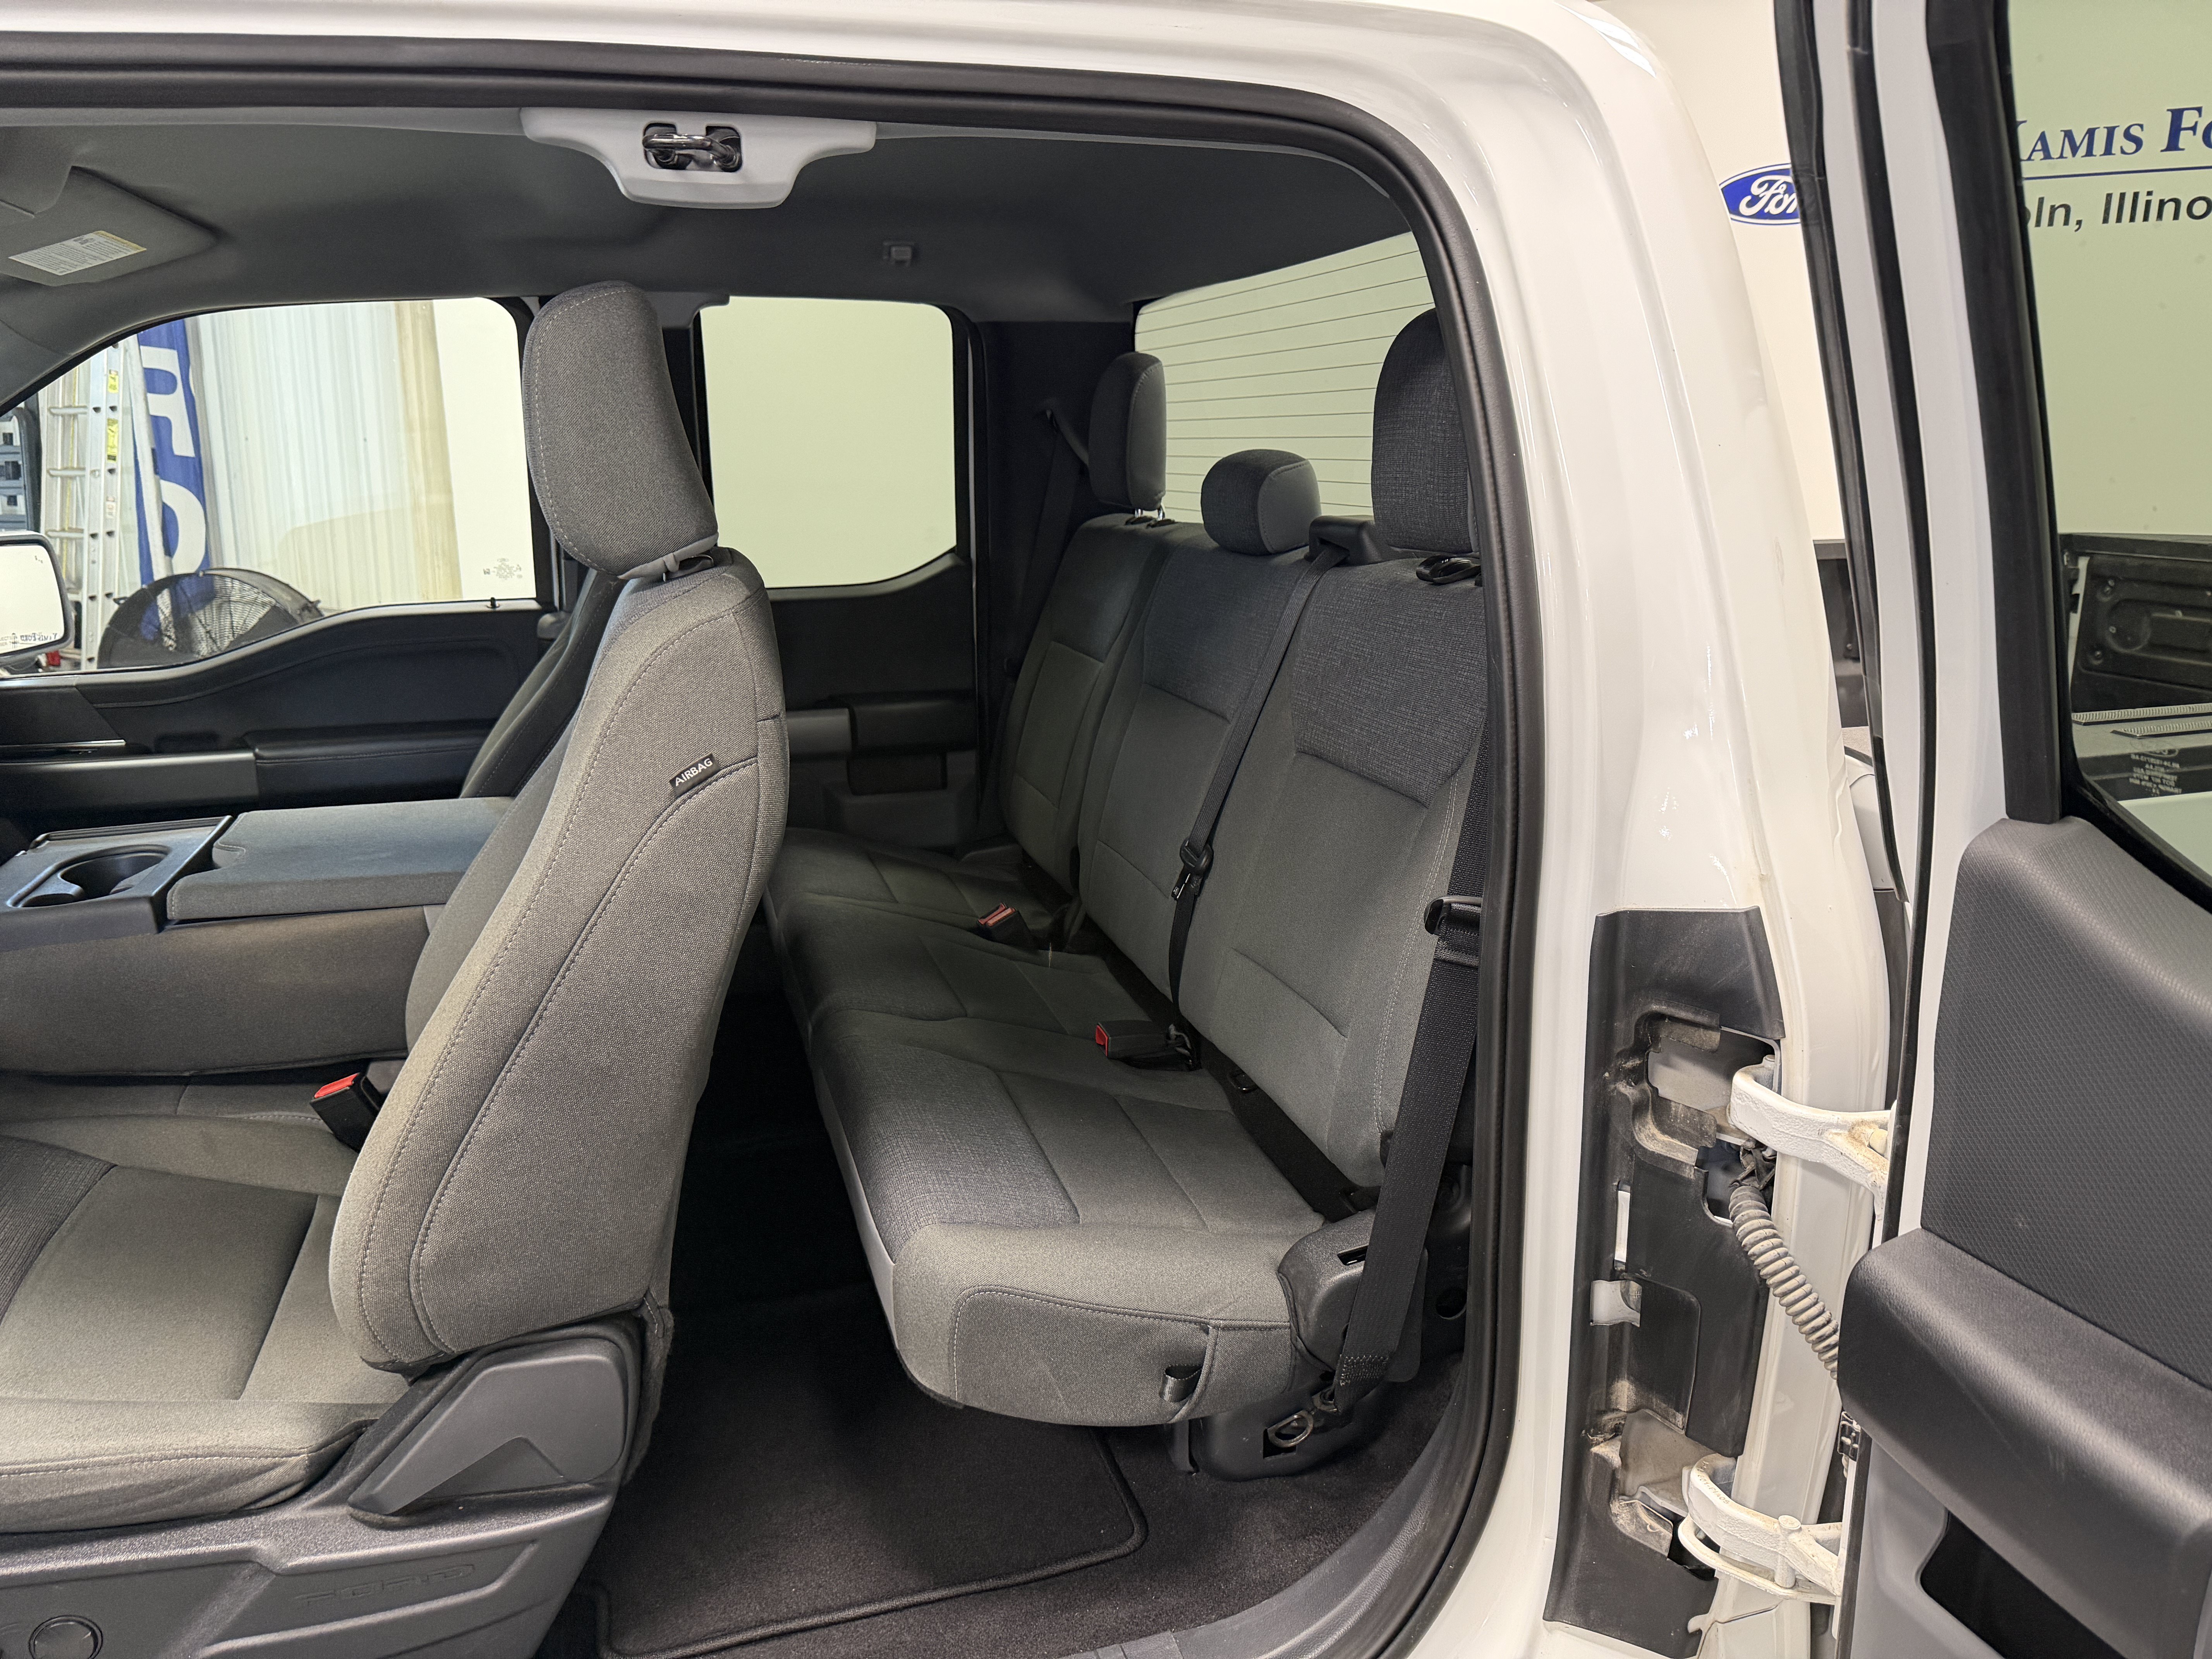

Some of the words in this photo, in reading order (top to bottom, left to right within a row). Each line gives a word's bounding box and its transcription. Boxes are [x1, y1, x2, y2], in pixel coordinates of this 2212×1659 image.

[2016, 120, 2144, 162] AMIS
[2025, 196, 2083, 233] ln,
[2102, 190, 2212, 225] Illino
[675, 757, 713, 787] AIRBAG
[293, 1563, 475, 1607] FORD
